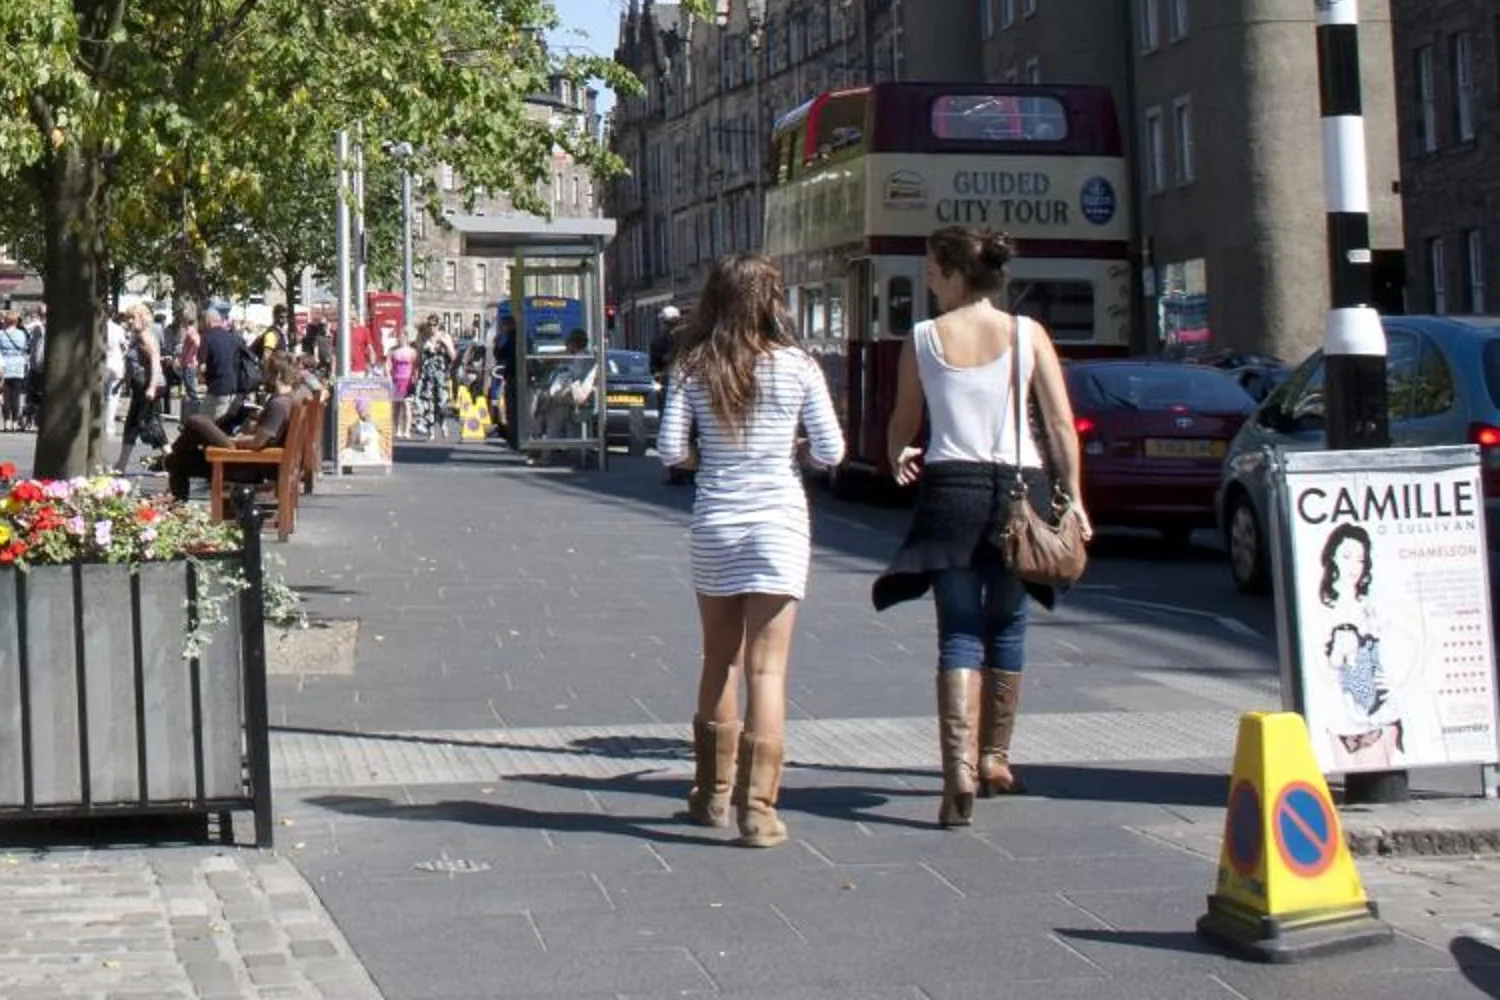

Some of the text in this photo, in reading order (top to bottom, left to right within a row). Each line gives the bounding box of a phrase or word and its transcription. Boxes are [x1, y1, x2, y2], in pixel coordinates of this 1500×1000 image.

[952, 170, 1050, 196] GUIDED
[936, 199, 991, 224] CITY
[999, 200, 1069, 226] TOUR
[1297, 481, 1474, 525] CAMILLE
